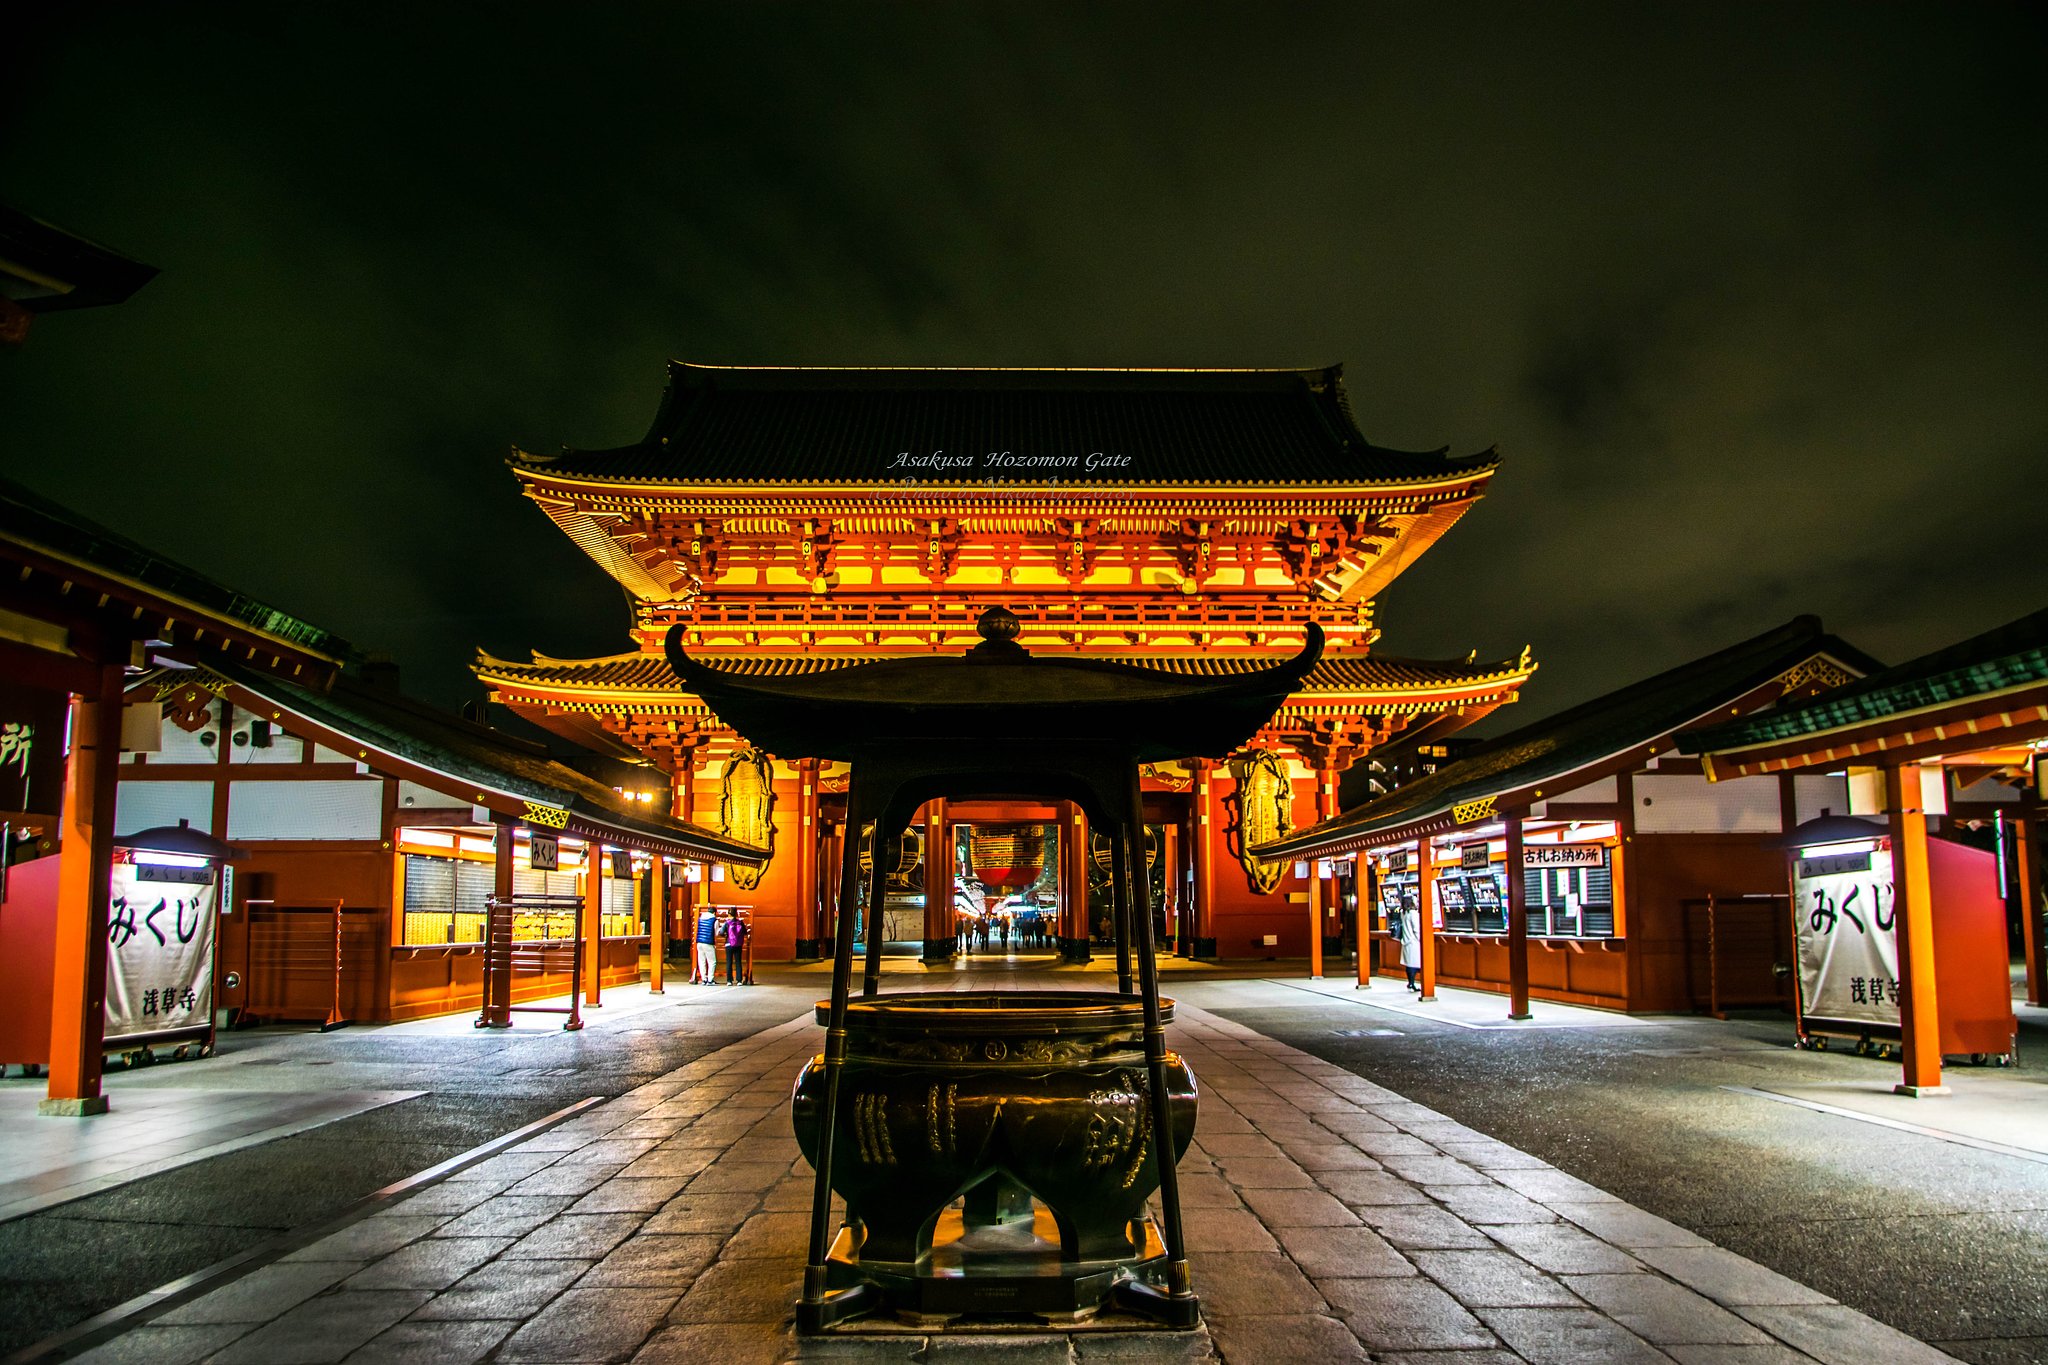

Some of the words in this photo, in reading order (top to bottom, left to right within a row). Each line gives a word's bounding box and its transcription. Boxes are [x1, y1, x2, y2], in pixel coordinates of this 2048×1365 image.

[0, 722, 33, 779] 所
[1523, 848, 1599, 864] 古札お納め所
[108, 896, 200, 949] みくじ
[1810, 881, 1895, 935] みくじ
[143, 985, 196, 1016] 浅草寺
[1850, 977, 1900, 1007] 浅草寺
